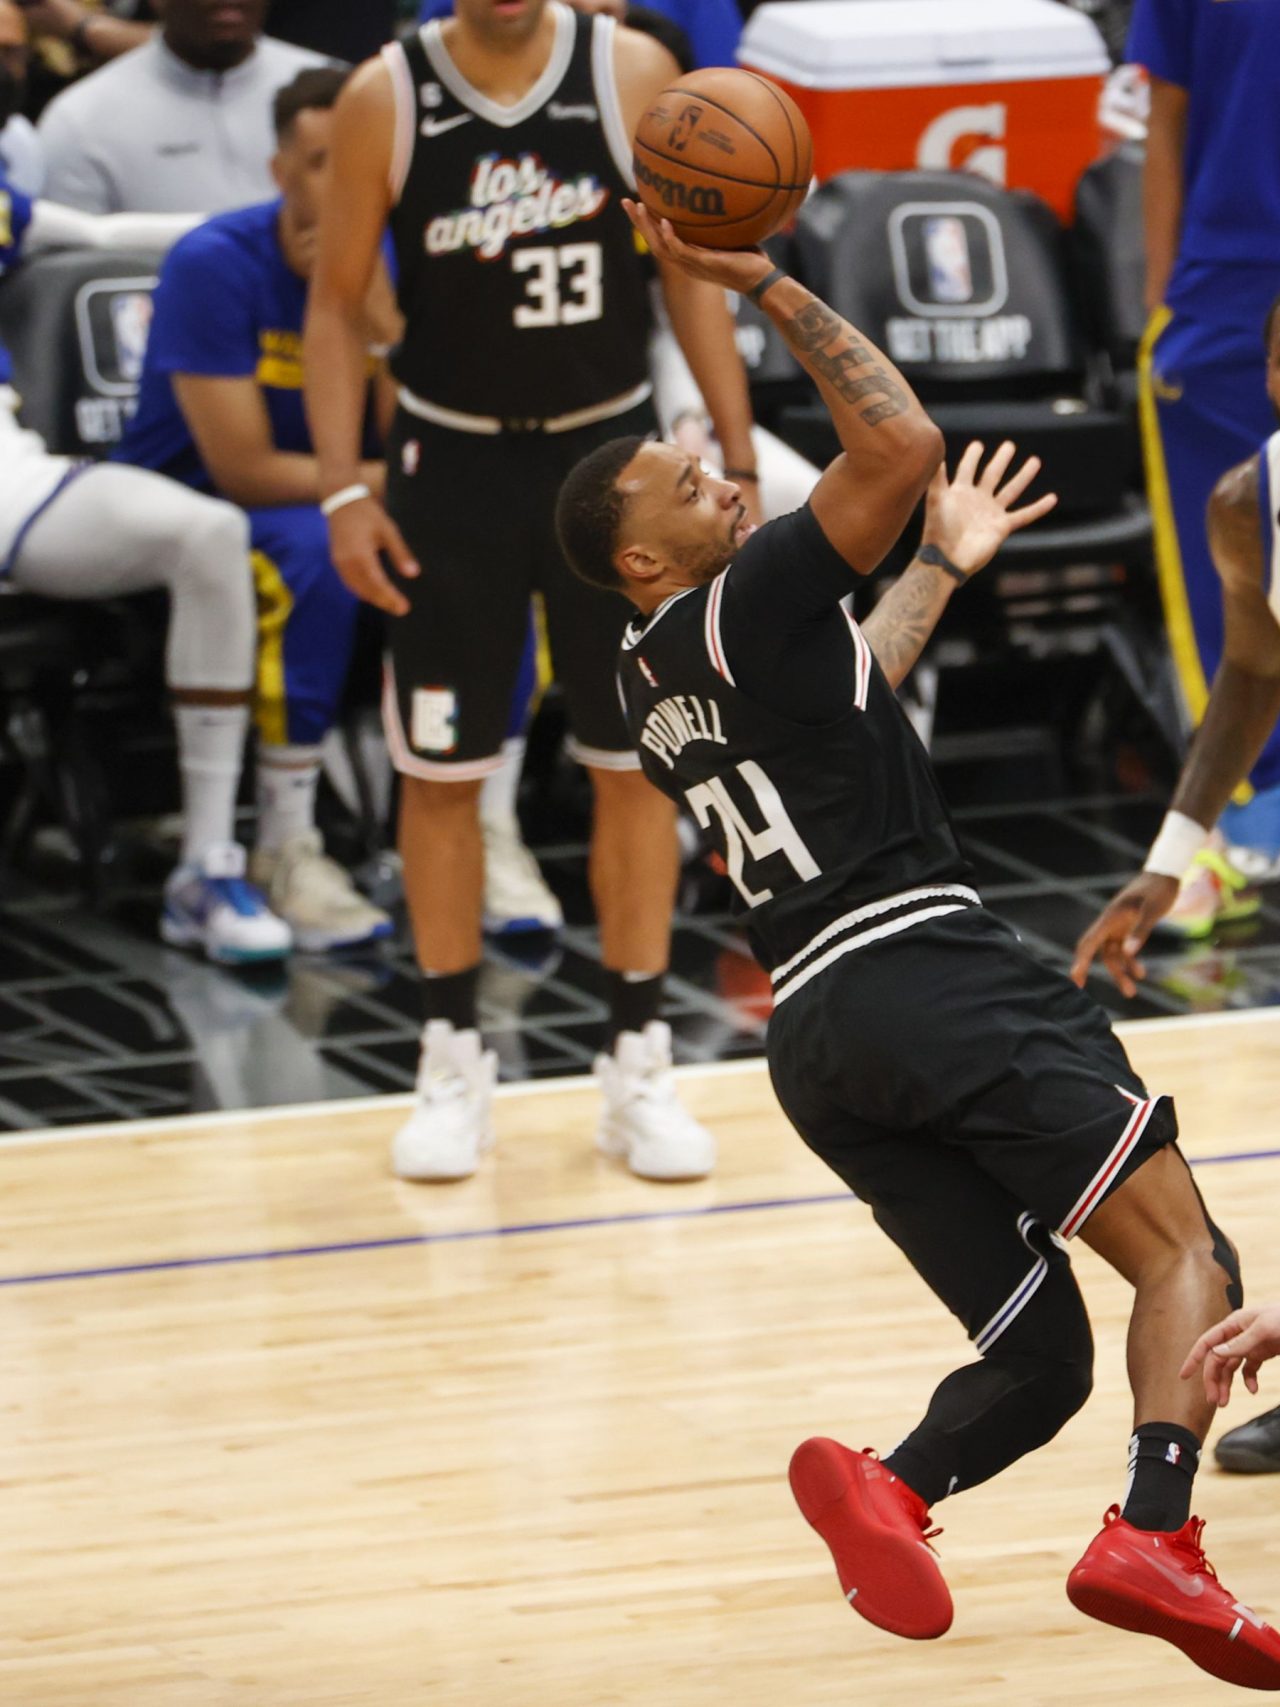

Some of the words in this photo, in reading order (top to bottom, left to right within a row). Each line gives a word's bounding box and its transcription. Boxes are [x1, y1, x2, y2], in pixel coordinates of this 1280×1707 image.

[423, 172, 610, 262] angeles
[469, 151, 547, 208] los
[511, 242, 603, 329] 33
[640, 695, 728, 770] POWELL
[684, 759, 823, 909] 24
